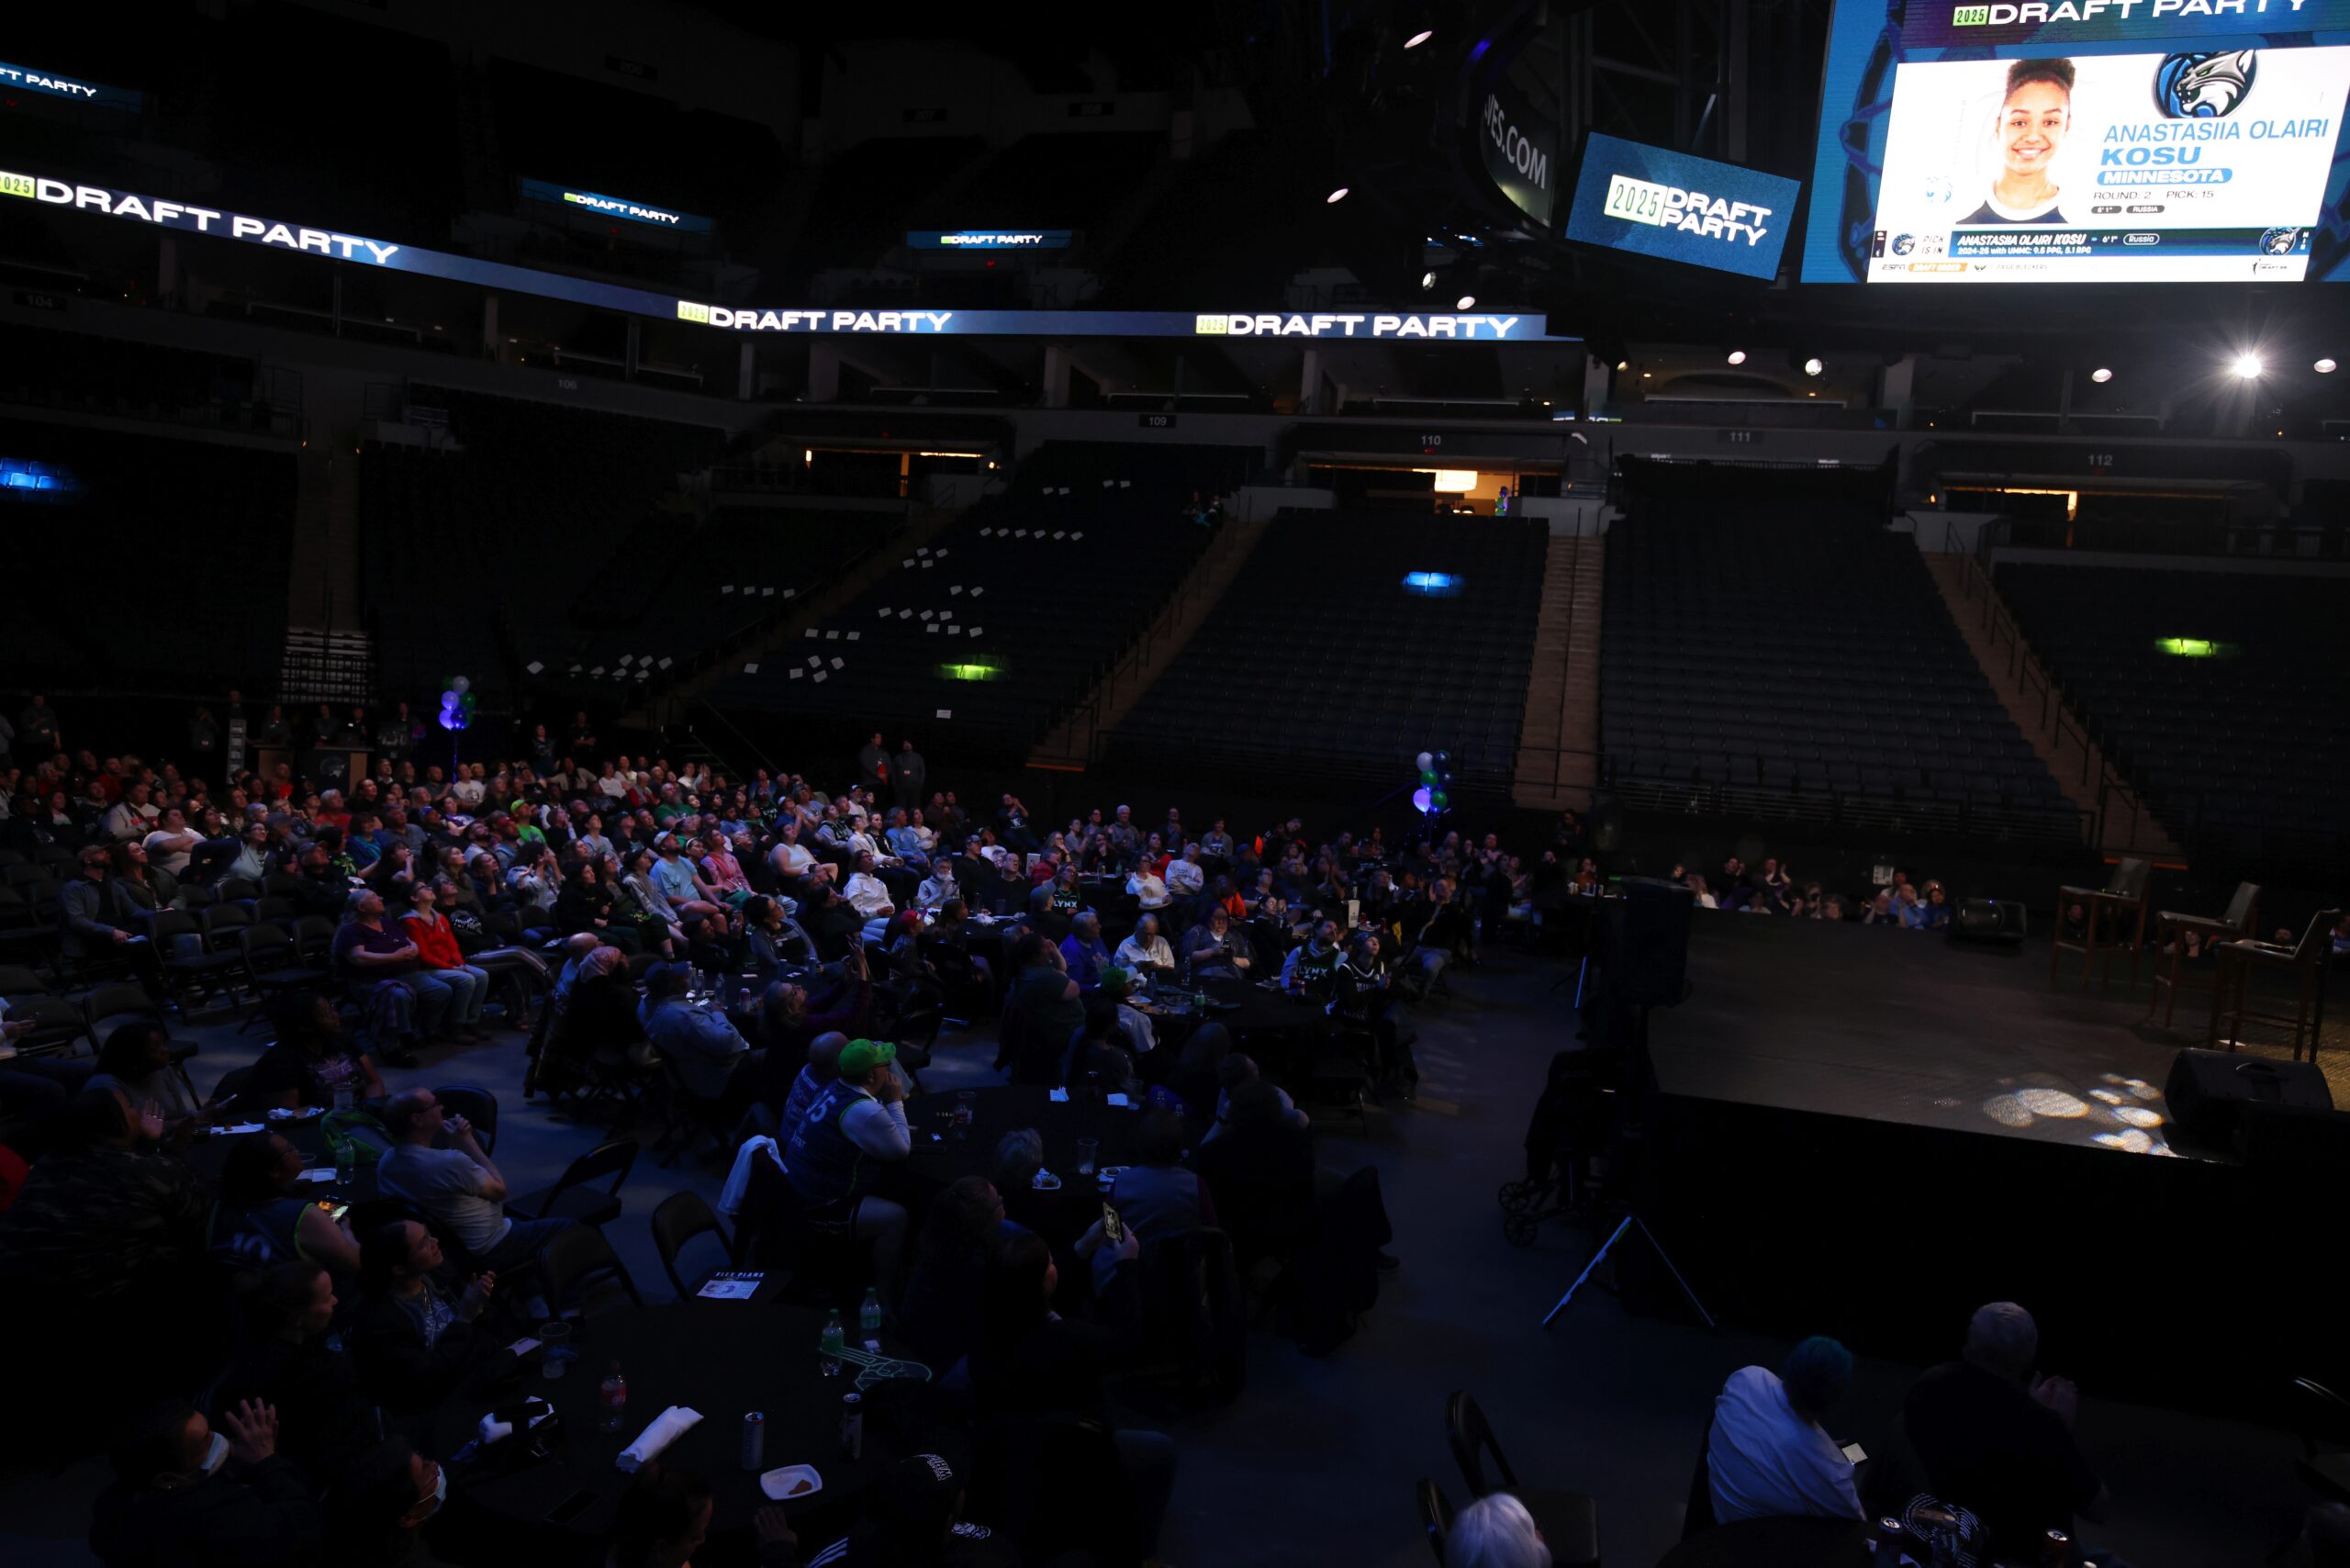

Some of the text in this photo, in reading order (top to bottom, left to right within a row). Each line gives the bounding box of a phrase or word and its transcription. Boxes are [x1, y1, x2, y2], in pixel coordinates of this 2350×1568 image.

[1956, 8, 1986, 24] 2025
[1988, 0, 2143, 25] DRAFT
[26, 73, 96, 97] PARTY
[2103, 118, 2330, 143] ANASTASIIA OLAIRI
[2100, 146, 2201, 166] KOSU
[2103, 169, 2224, 185] MINNESOTA
[2093, 190, 2214, 200] ROUND: 2 PICK: 15
[576, 195, 627, 212] DRAFT
[630, 207, 678, 223] PARTY
[1613, 183, 1772, 227] 2025 DRAFT
[0, 176, 398, 263] 025 DRAFT PARTY
[1660, 207, 1767, 246] PARTY
[952, 235, 995, 243] DRAFT
[997, 235, 1042, 243] PARTY
[1957, 235, 2018, 246] ANASTASIIA
[2019, 234, 2053, 245] OLAIRI
[2053, 233, 2087, 245] KOSU
[2128, 235, 2154, 243] Russia
[1991, 246, 2007, 254] with
[681, 305, 952, 331] 2025 DRAFT PARTY
[1199, 315, 1518, 338] 2025 DRAFT PARTY
[1148, 417, 1167, 426] 109
[1421, 435, 1441, 446] 110
[1729, 431, 1751, 442] 111
[2087, 454, 2113, 465] 112
[1053, 900, 1078, 908] LYNX
[1299, 966, 1328, 978] LYNX
